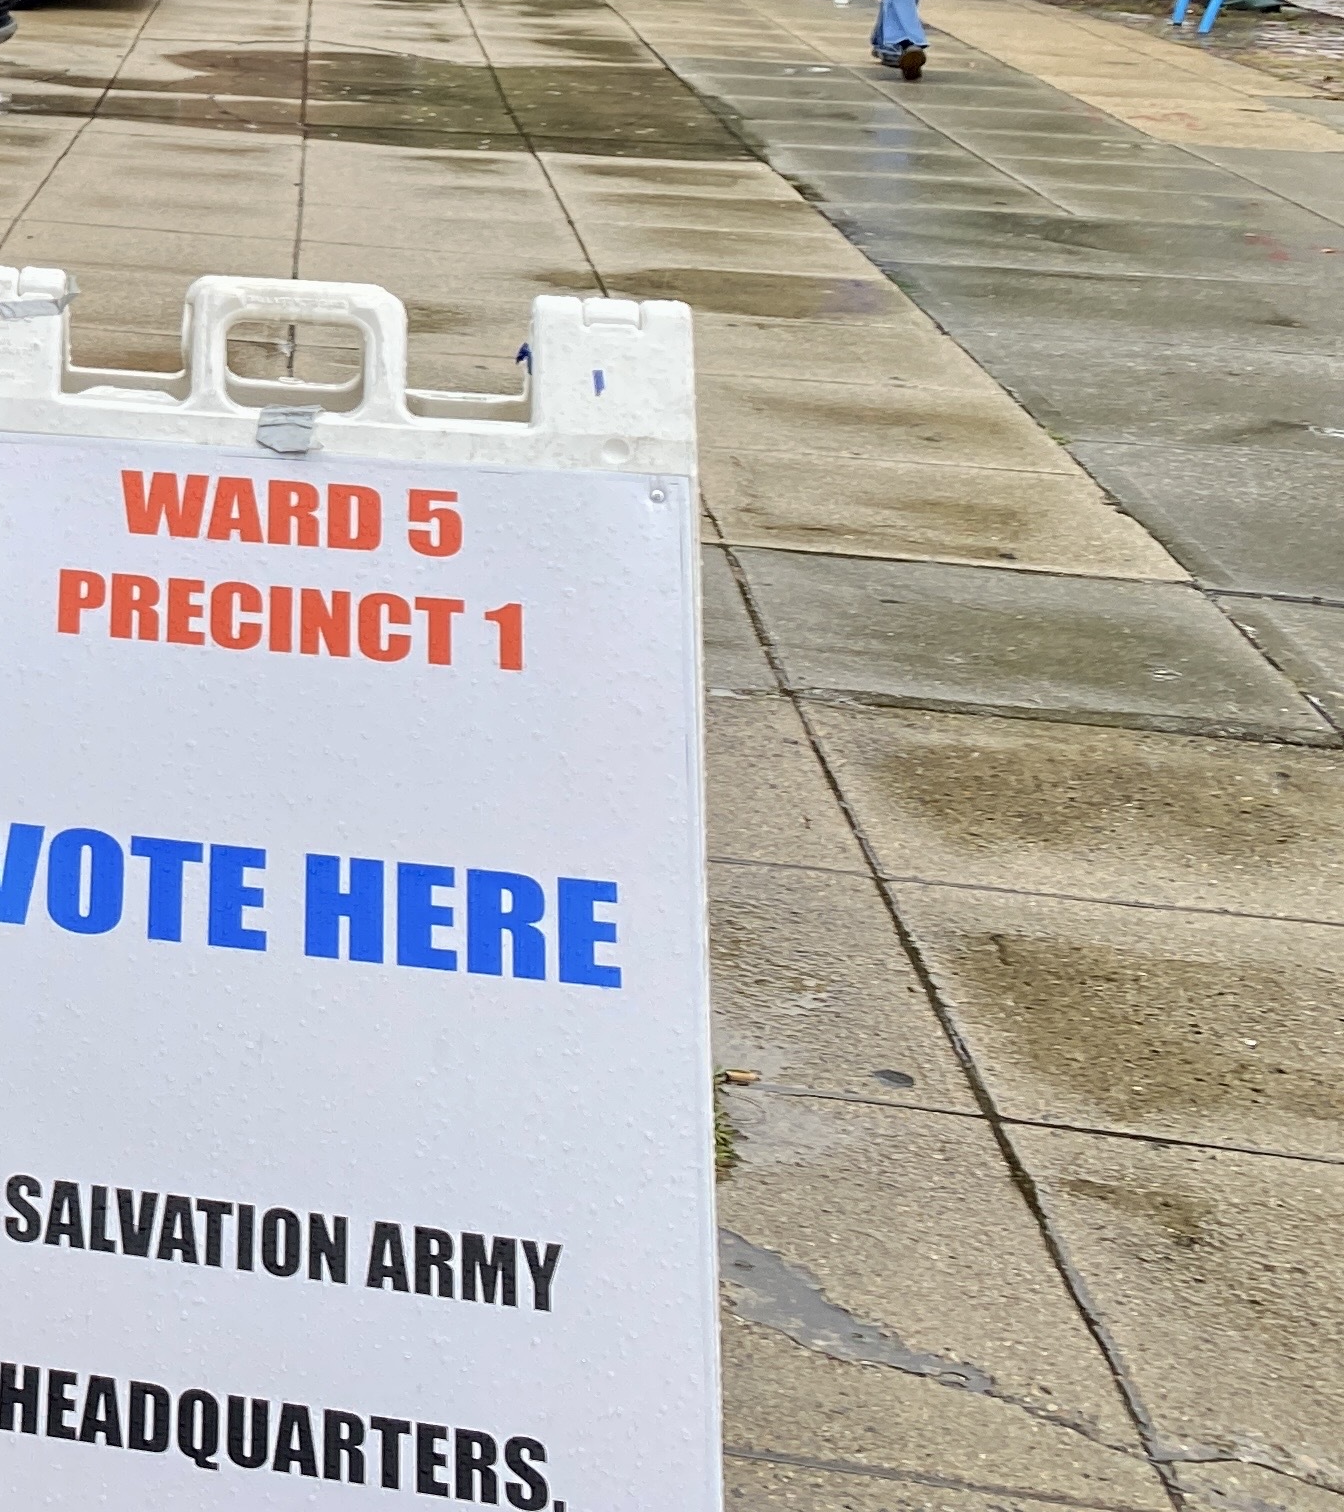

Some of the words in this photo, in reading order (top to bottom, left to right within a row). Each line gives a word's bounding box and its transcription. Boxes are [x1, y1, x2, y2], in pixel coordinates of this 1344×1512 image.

[121, 469, 381, 551] WARD
[408, 488, 463, 558] 5
[57, 568, 465, 666] PRECINCT
[484, 603, 523, 671] 1
[304, 852, 622, 990] HERE
[4, 1173, 348, 1285] SALVATION
[366, 1220, 563, 1312] ARMY
